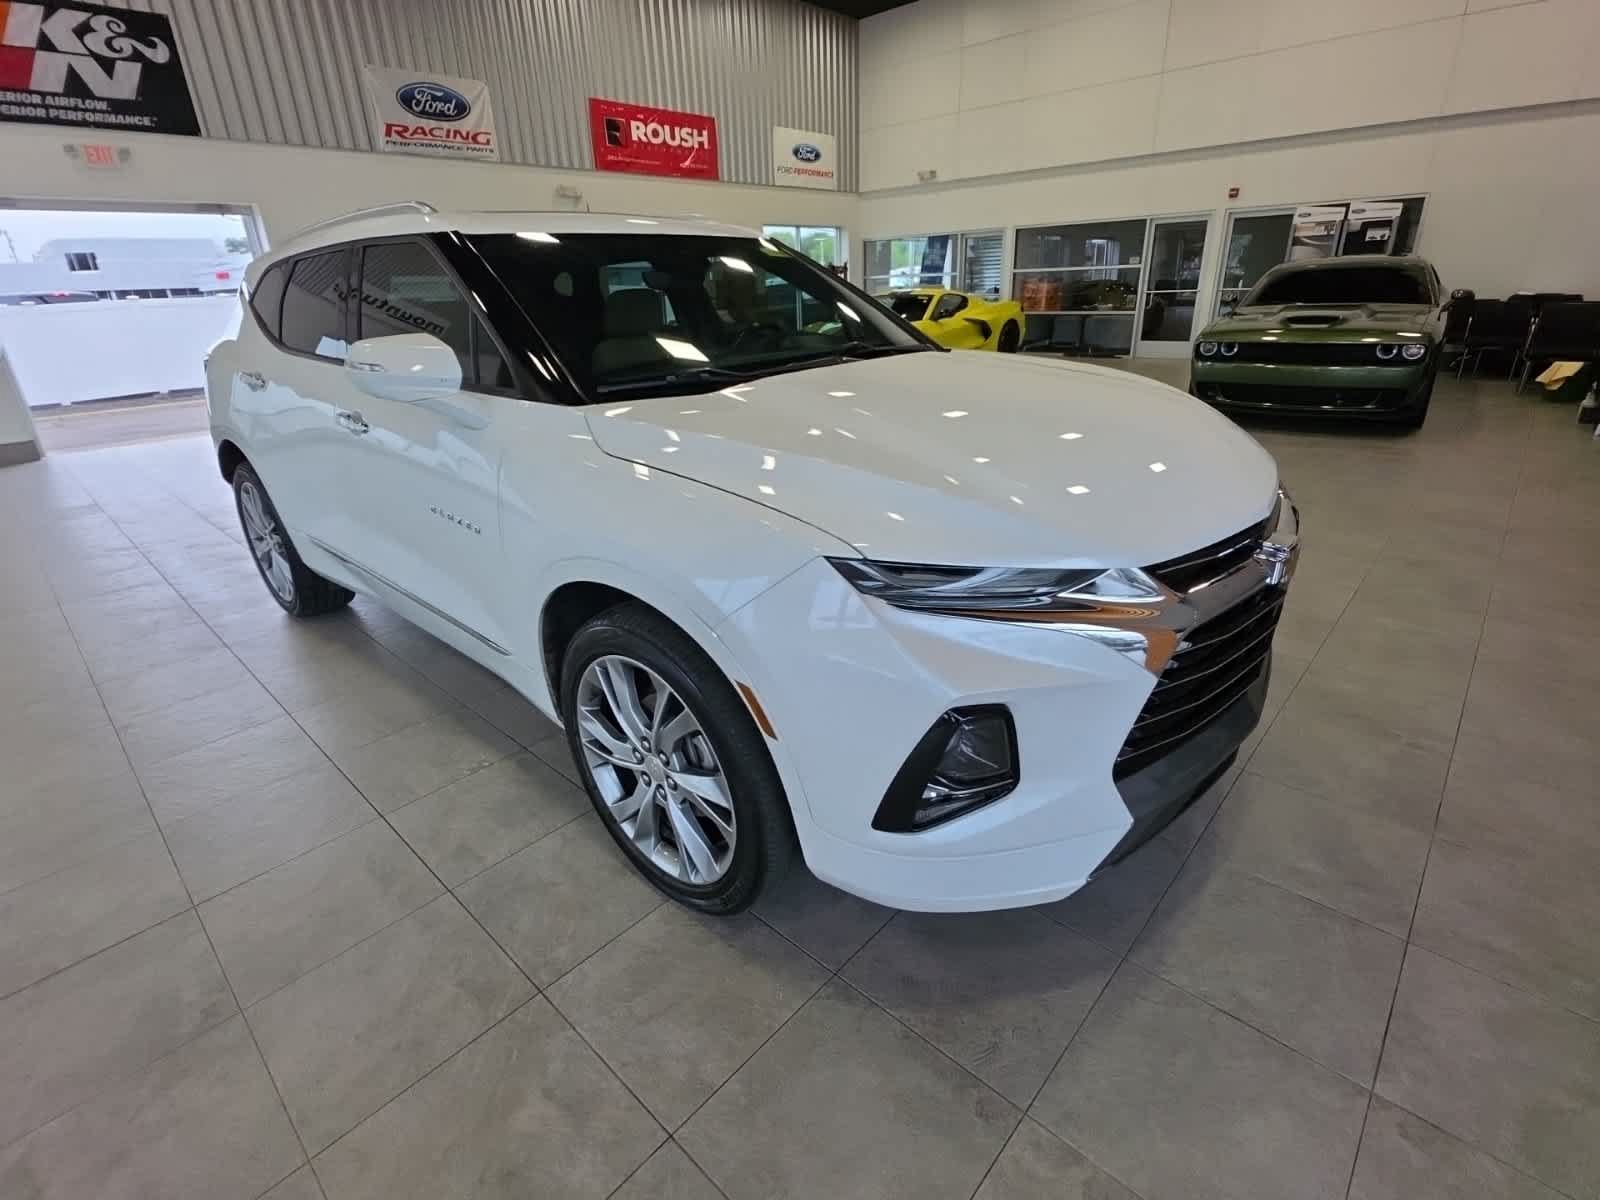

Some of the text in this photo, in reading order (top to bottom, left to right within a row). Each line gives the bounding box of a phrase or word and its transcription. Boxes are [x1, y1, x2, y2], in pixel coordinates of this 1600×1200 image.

[2, 3, 170, 100] K&N
[45, 95, 111, 111] AIRFLOW.
[411, 87, 458, 116] Ford
[384, 122, 491, 146] RACING
[630, 119, 709, 149] ROUSH
[86, 146, 113, 164] EXIT
[386, 139, 495, 154] PERFORMANCE PARTS
